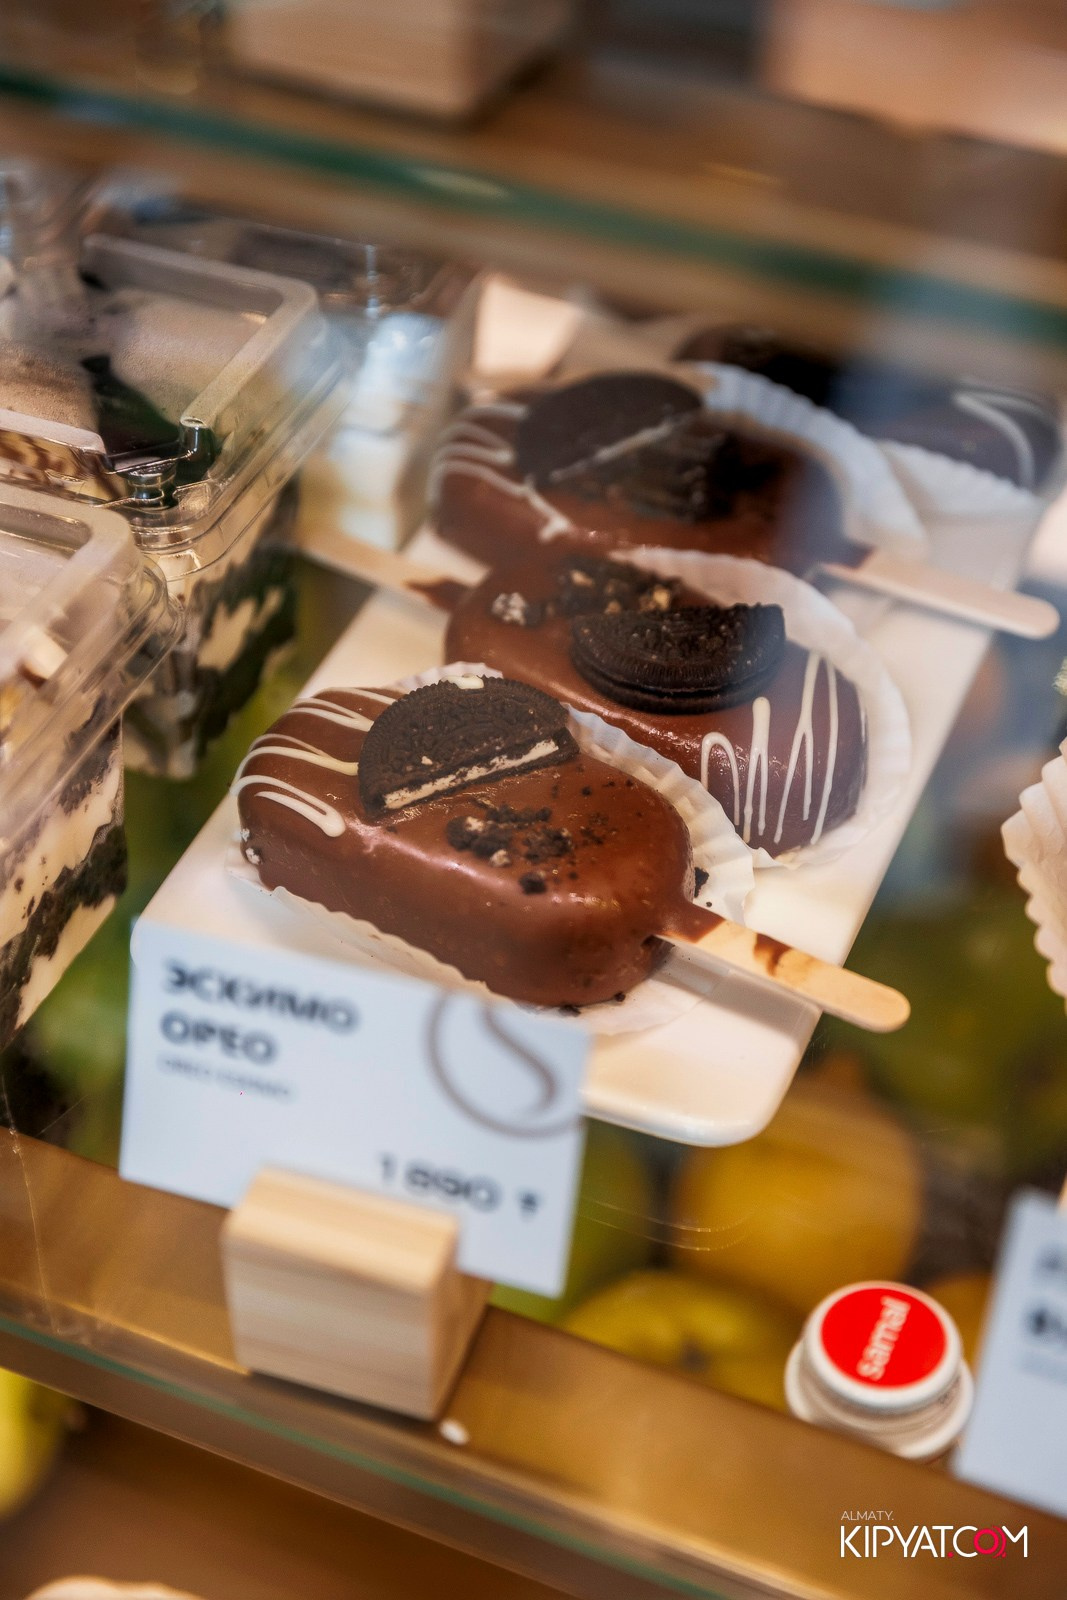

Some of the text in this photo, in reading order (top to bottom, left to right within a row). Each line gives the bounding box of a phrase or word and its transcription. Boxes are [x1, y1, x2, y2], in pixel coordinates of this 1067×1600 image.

[163, 959, 359, 1032] ЭСКИМО
[161, 1010, 277, 1064] ОРЕО
[857, 1296, 911, 1380] samal
